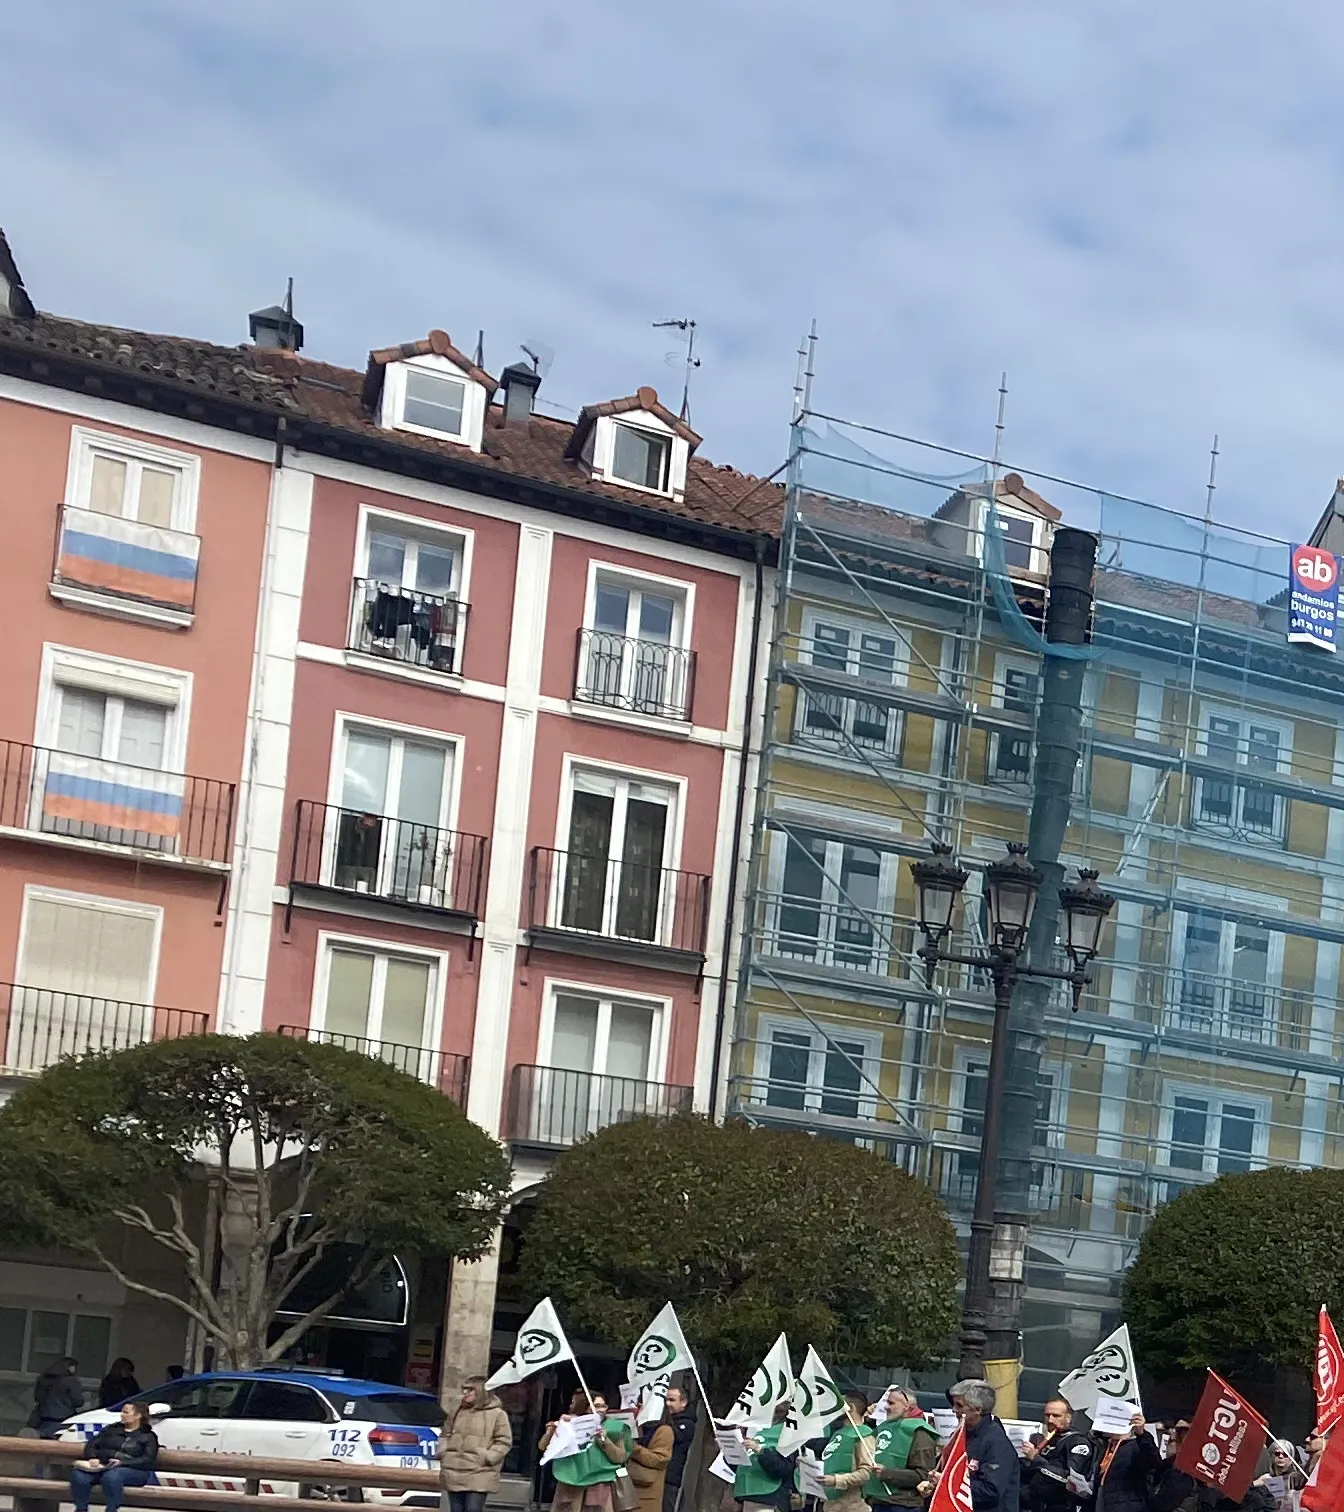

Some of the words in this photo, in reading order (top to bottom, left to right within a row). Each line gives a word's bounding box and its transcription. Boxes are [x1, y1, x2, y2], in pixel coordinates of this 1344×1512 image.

[1297, 555, 1332, 582] ab
[1291, 591, 1335, 609] andamios
[1290, 599, 1334, 620] burgos
[327, 1429, 361, 1442] 112
[331, 1443, 356, 1458] 092
[400, 1456, 419, 1469] 092
